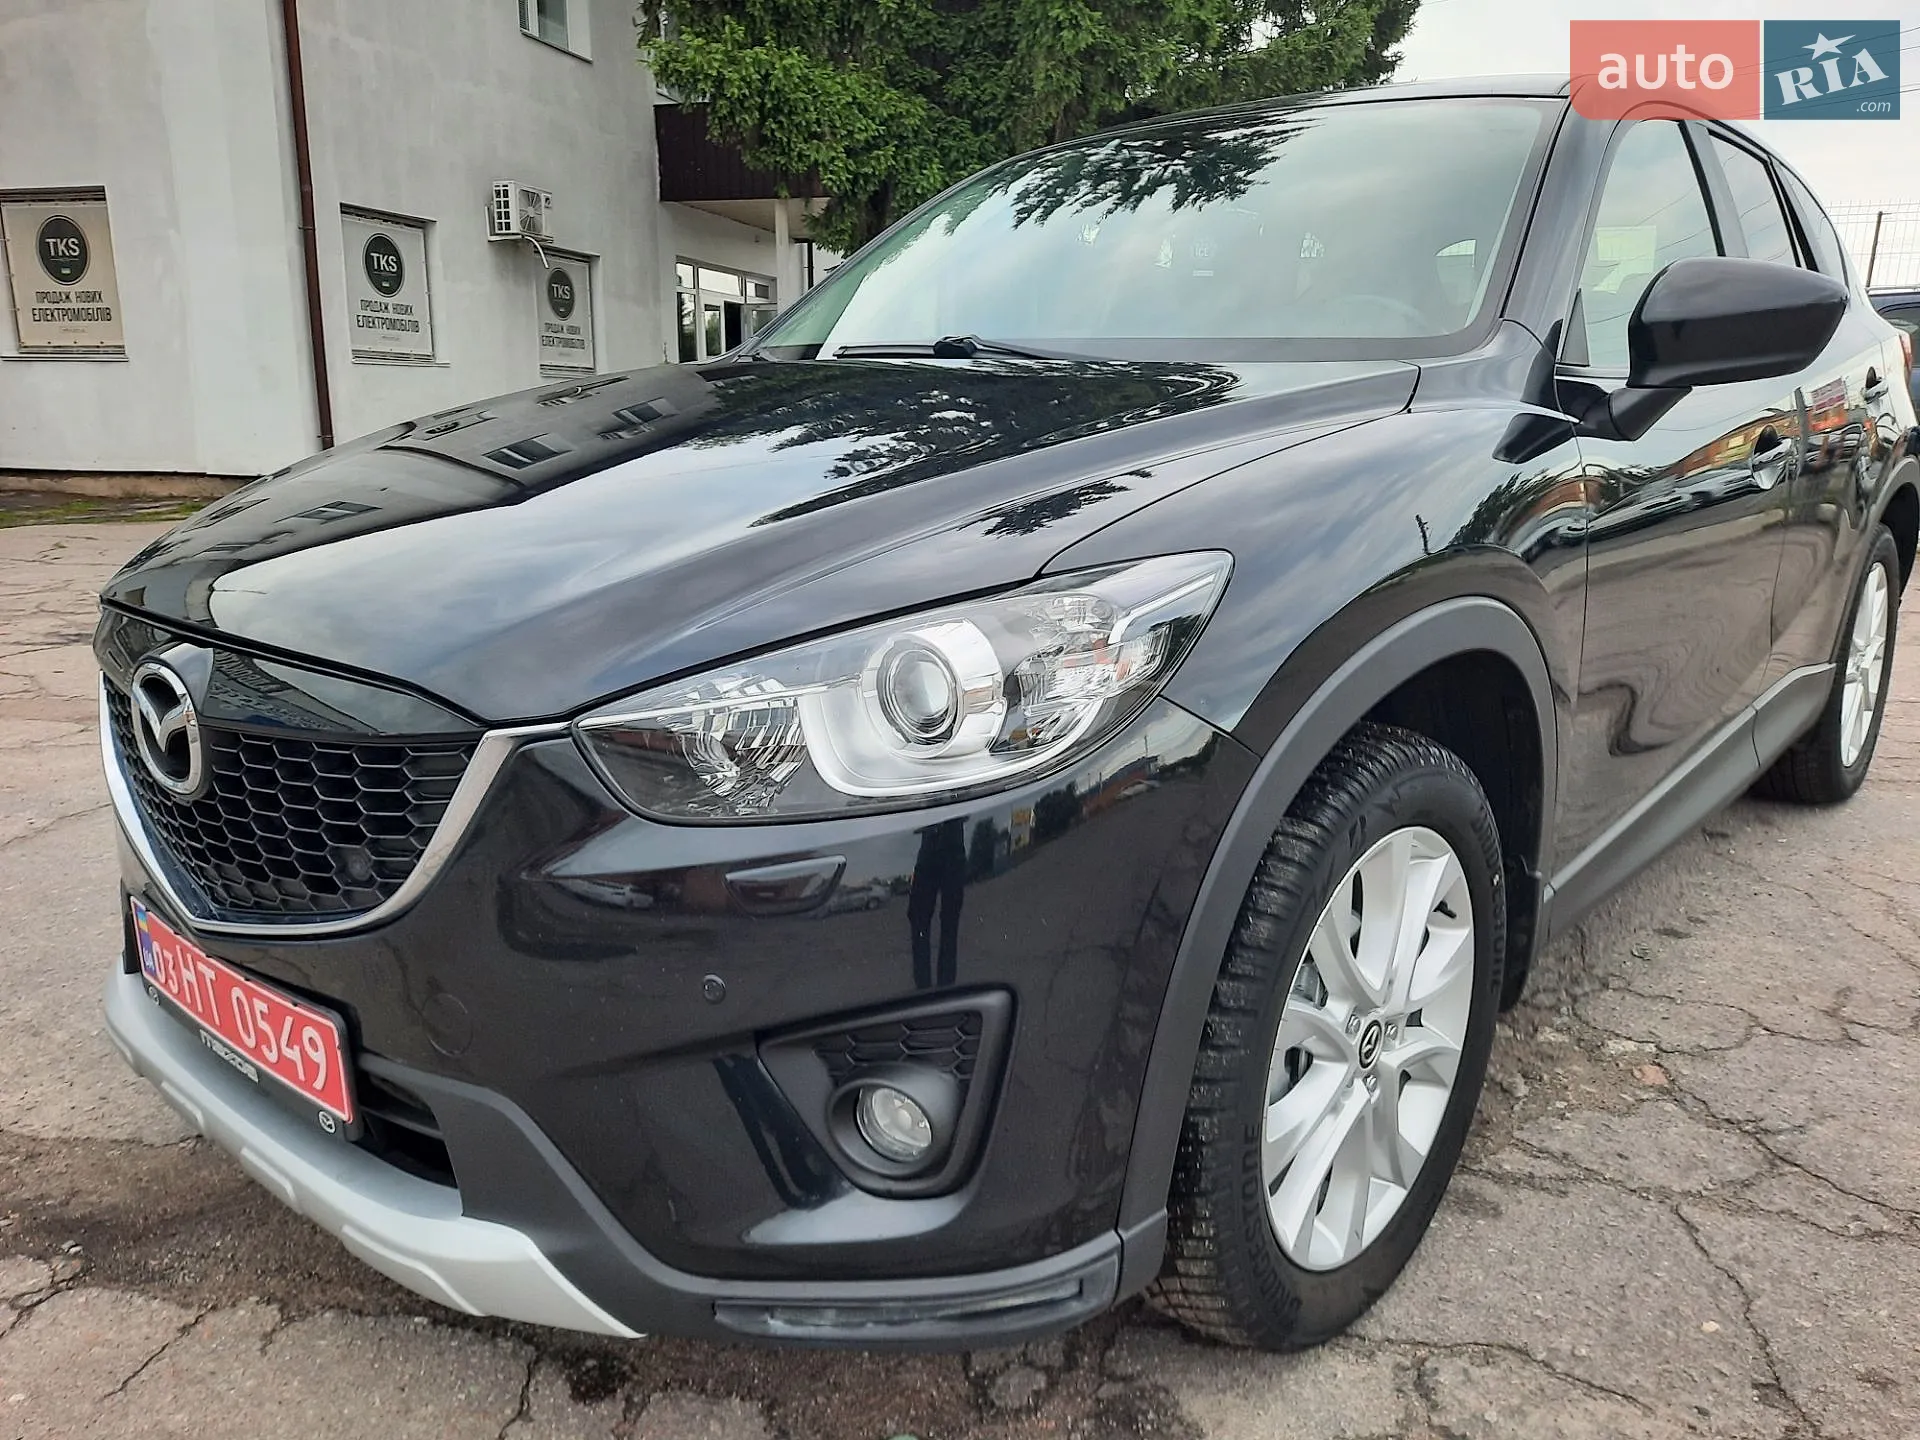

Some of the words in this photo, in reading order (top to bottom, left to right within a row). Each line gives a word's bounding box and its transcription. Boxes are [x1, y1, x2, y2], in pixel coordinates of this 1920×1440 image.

[45, 237, 80, 257] TKS
[369, 253, 398, 272] TKS
[35, 291, 73, 304] ПРОДАЖ
[75, 291, 103, 304] НОВИХ
[551, 284, 571, 299] TKS
[32, 307, 112, 322] ЕЛЕКТРОМОБІЛІВ
[360, 299, 390, 314] ПРОДАЖ
[356, 314, 420, 333] ЕЛЕКТРОМОБІЛІВ
[231, 986, 327, 1092] 0549
